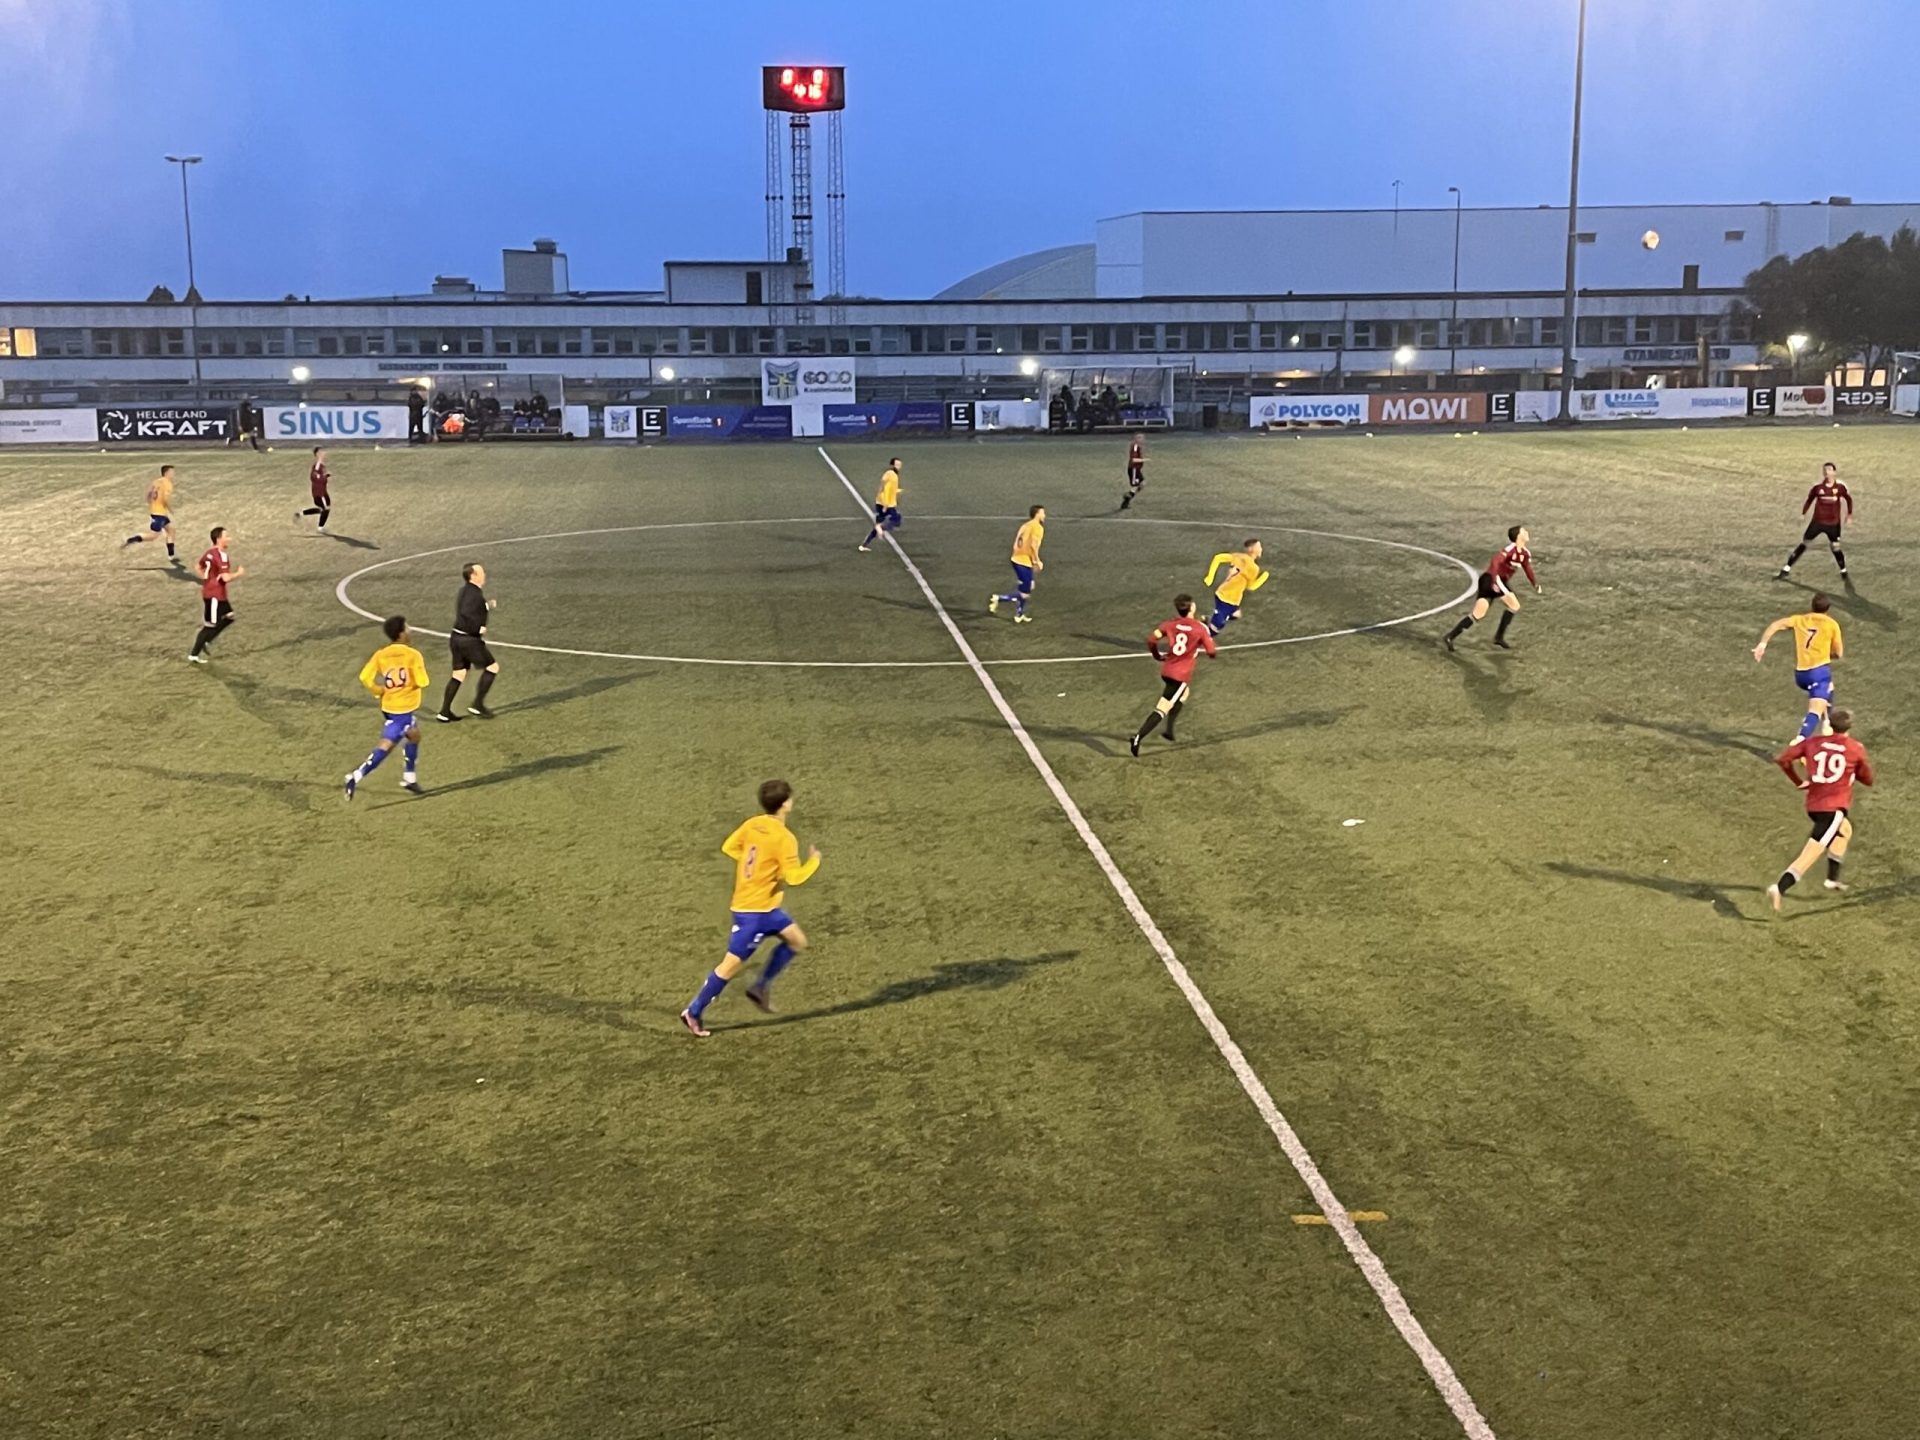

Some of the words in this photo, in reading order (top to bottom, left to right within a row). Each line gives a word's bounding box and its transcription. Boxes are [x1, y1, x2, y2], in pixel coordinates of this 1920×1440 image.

[136, 410, 208, 419] HELGELAND
[1278, 403, 1361, 418] POLYGON
[1381, 397, 1468, 421] MOWI
[137, 420, 228, 436] KRAFT
[278, 410, 383, 436] SINUS
[1172, 632, 1189, 656] 8
[1805, 628, 1818, 649] 7
[1811, 750, 1847, 784] 19
